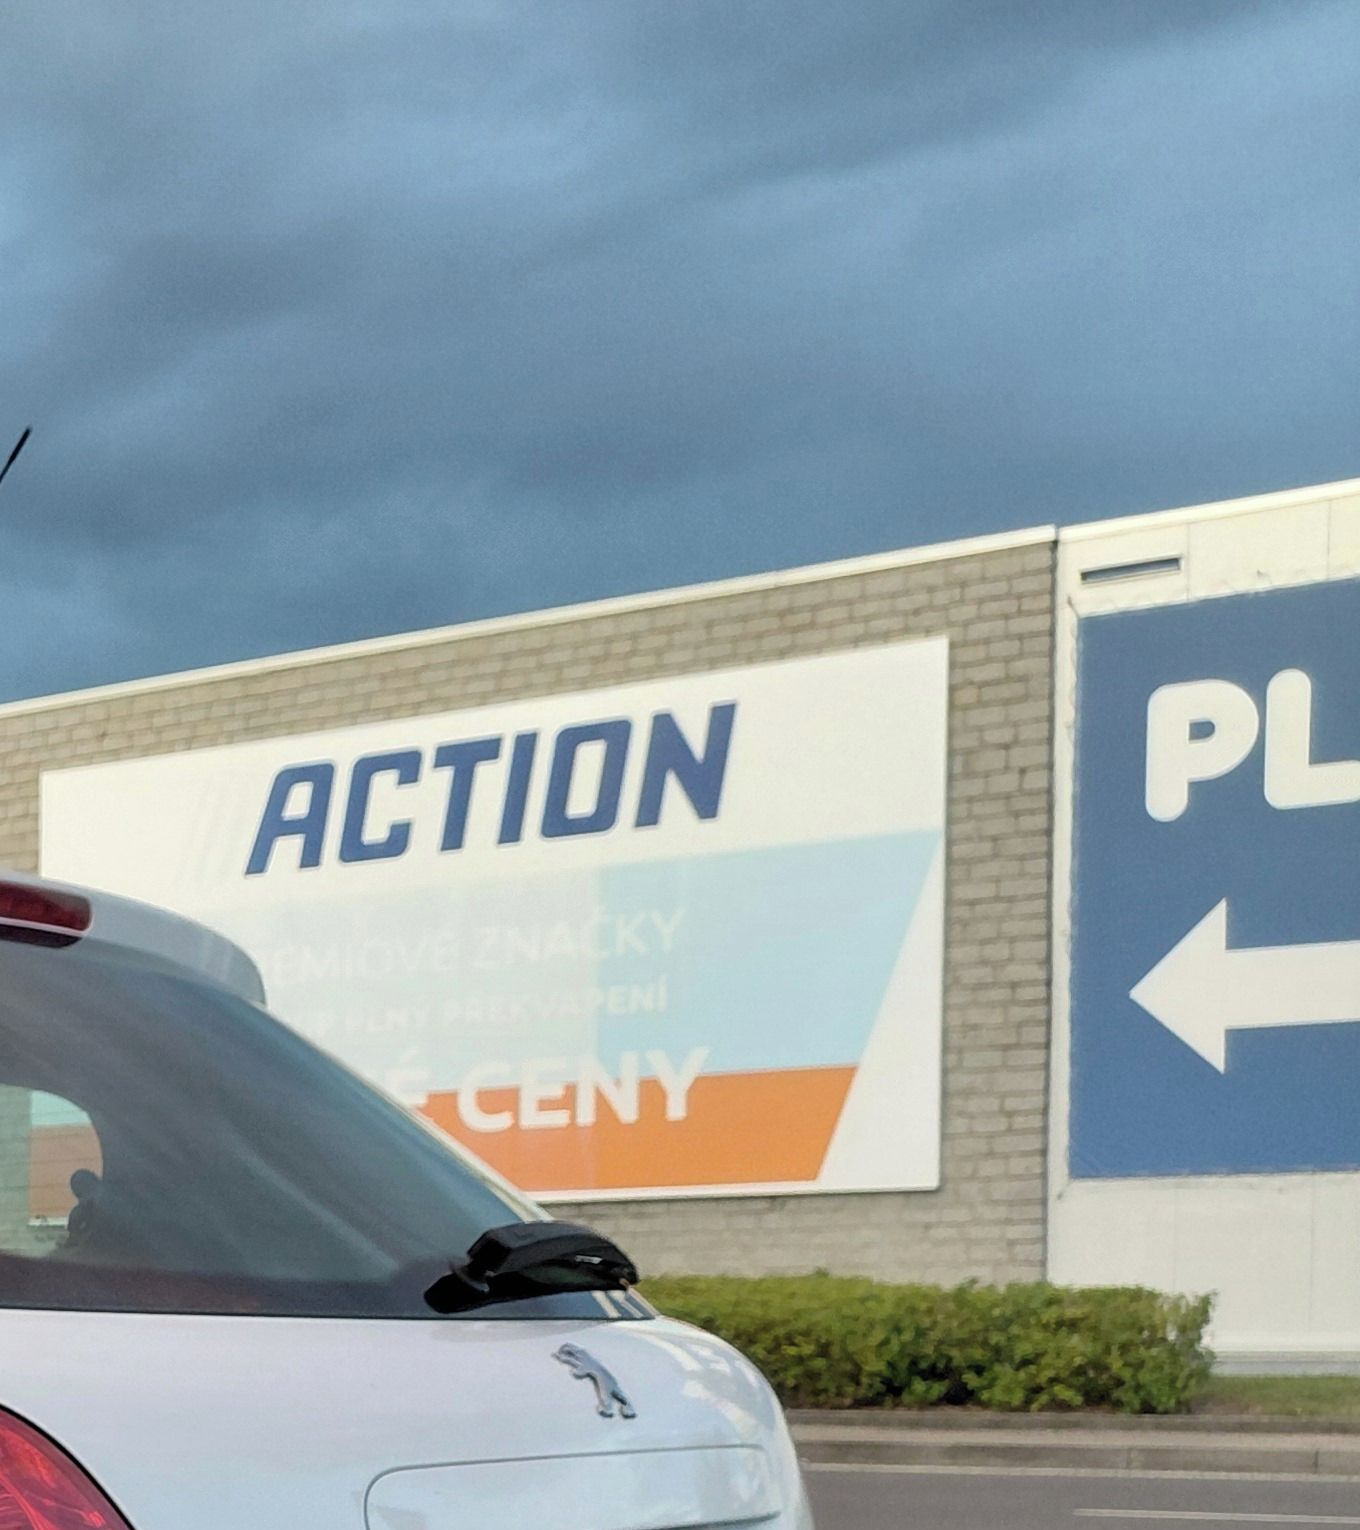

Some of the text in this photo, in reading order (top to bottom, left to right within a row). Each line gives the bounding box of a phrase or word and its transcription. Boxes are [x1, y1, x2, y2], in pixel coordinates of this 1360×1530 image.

[244, 699, 739, 877] ACTION
[1145, 668, 1360, 823] PL
[474, 903, 687, 970] ZNAČKY
[456, 1046, 710, 1133] CENY
